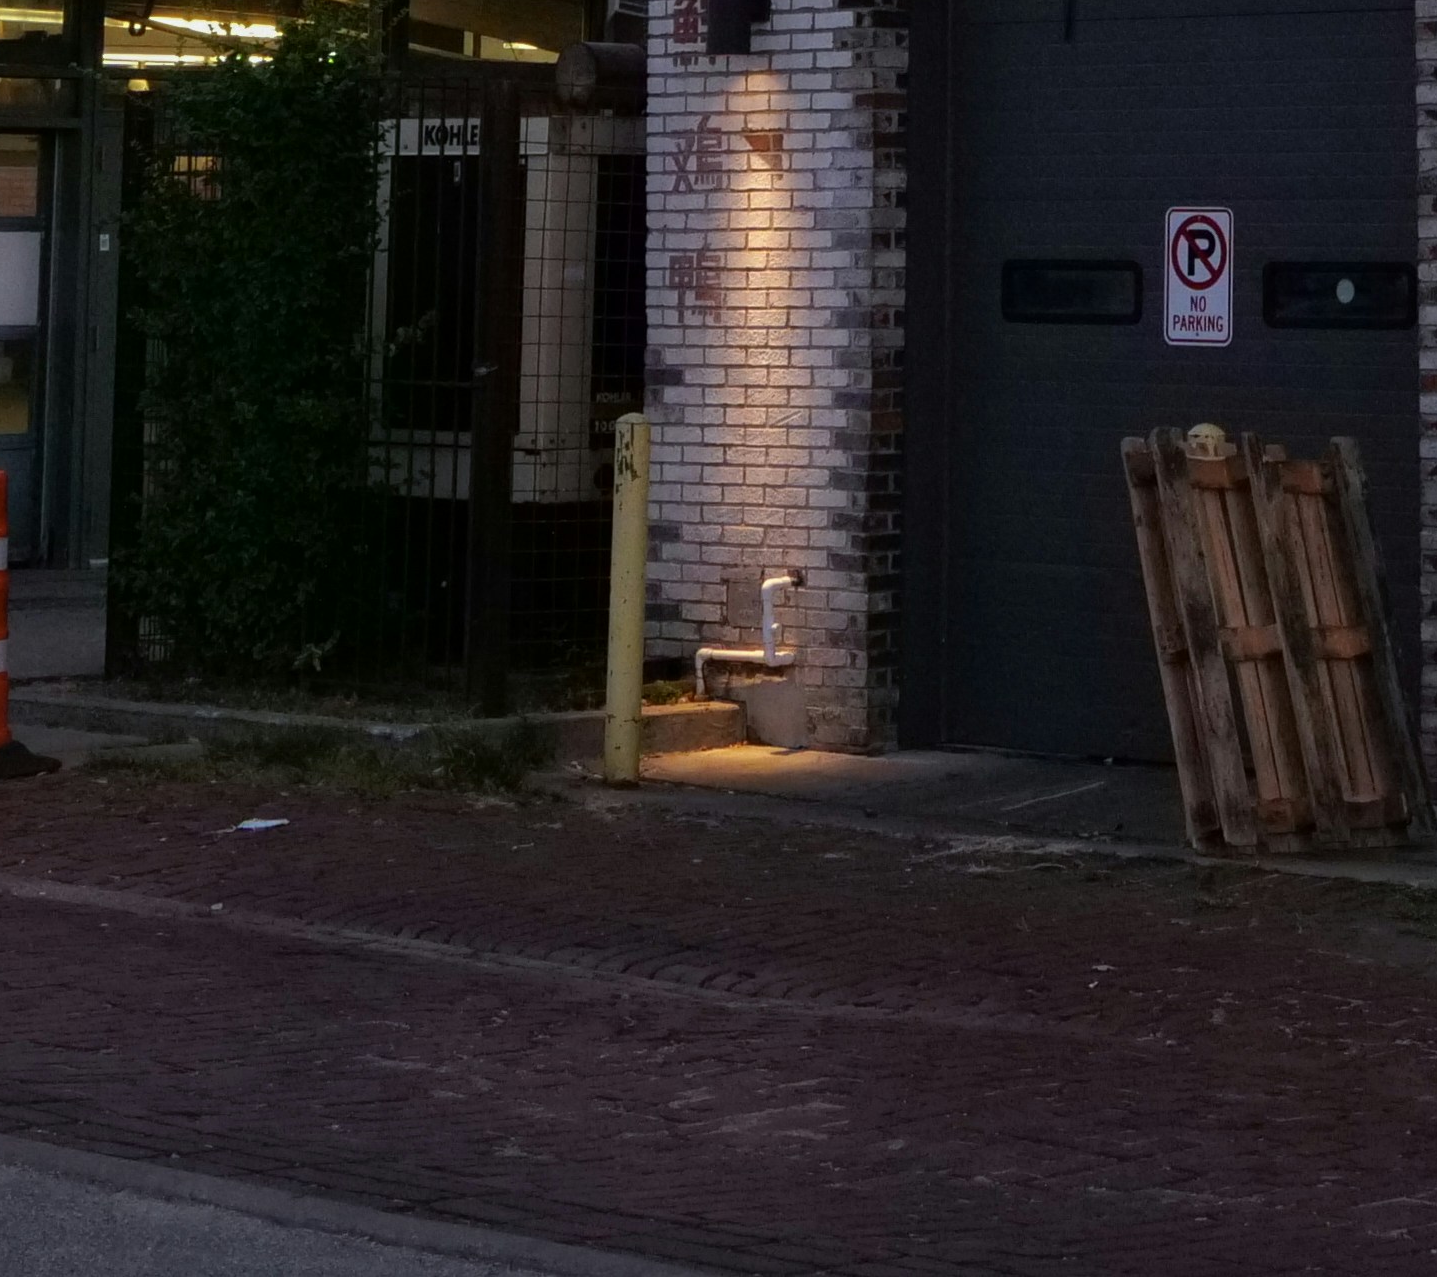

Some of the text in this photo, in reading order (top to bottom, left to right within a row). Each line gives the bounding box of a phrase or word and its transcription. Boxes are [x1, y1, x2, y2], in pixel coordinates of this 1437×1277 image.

[425, 125, 479, 146] KOHLE
[1190, 295, 1207, 312] NO
[1173, 315, 1224, 333] PARKING
